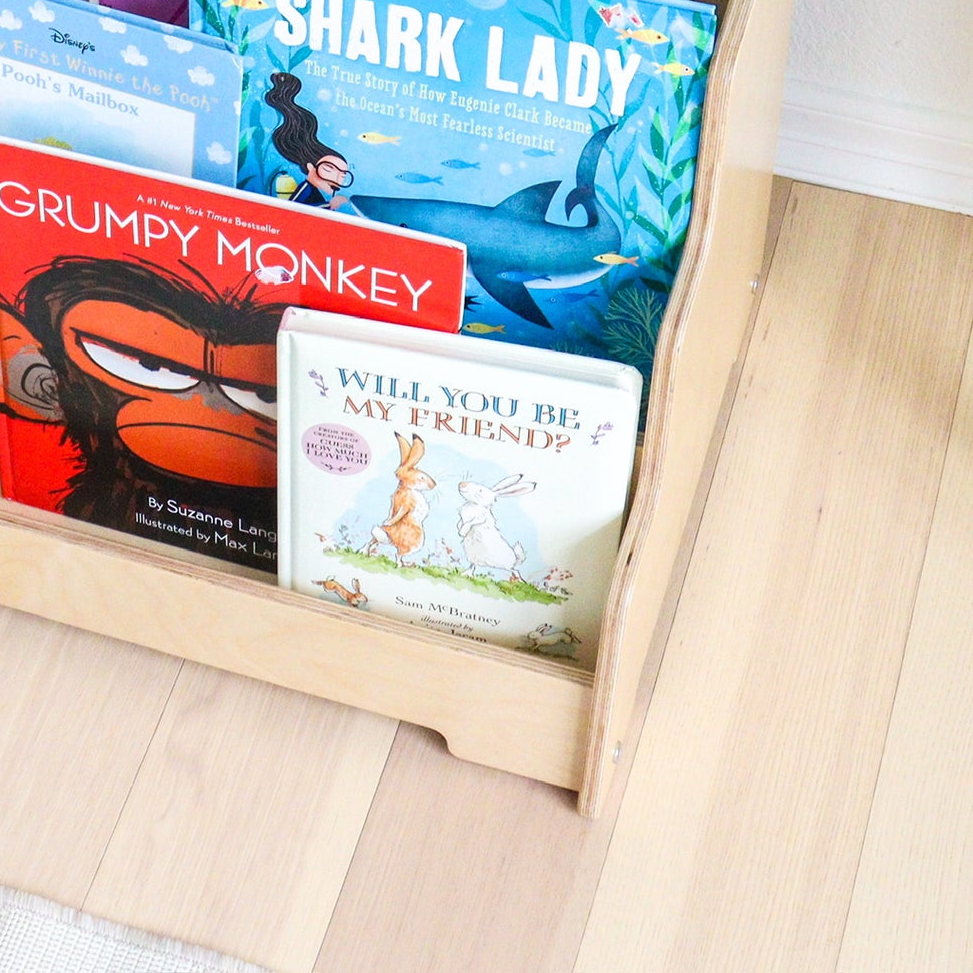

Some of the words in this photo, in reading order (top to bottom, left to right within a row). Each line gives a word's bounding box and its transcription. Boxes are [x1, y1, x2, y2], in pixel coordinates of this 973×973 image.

[48, 27, 96, 54] Disney's
[2, 63, 62, 93] Pooh's
[67, 81, 140, 117] Mailbox
[12, 39, 60, 66] First
[66, 53, 125, 85] Winnie
[131, 72, 163, 95] the
[485, 26, 642, 117] LADY
[305, 60, 328, 77] The
[331, 65, 362, 84] True
[365, 71, 398, 97] Story
[402, 82, 415, 96] of
[418, 85, 446, 104] How
[450, 90, 501, 115] Eugenie
[504, 101, 540, 125] Clark
[544, 108, 593, 136] Became
[336, 89, 356, 109] the
[359, 93, 405, 120] Ocean's
[409, 106, 439, 128] Most
[443, 114, 494, 139] Fearless
[497, 126, 556, 152] Scientist
[137, 194, 144, 202] A
[147, 198, 157, 206] #1
[160, 200, 181, 211] New
[185, 205, 204, 218] York
[207, 210, 233, 225] Times
[235, 217, 281, 236] Bestseller
[217, 230, 432, 313] MONKEY
[336, 368, 430, 403] WILL
[439, 385, 519, 417] YOU
[532, 403, 581, 429] BE
[313, 431, 347, 441] CREATORS
[343, 395, 394, 422] MY
[409, 409, 572, 454] FRIEND?
[307, 443, 331, 452] HOW
[335, 448, 368, 458] MUCH
[314, 451, 342, 460] LOVE
[345, 455, 368, 465] YOU
[135, 512, 193, 537] Illustrated
[196, 528, 211, 544] by
[214, 531, 248, 553] Max
[148, 496, 165, 511] By
[167, 499, 234, 529] Suzanne
[238, 518, 277, 543] Lang
[395, 596, 423, 609] Sam
[429, 602, 501, 627] McBratney
[420, 616, 463, 629] illustrated
[463, 624, 474, 633] by
